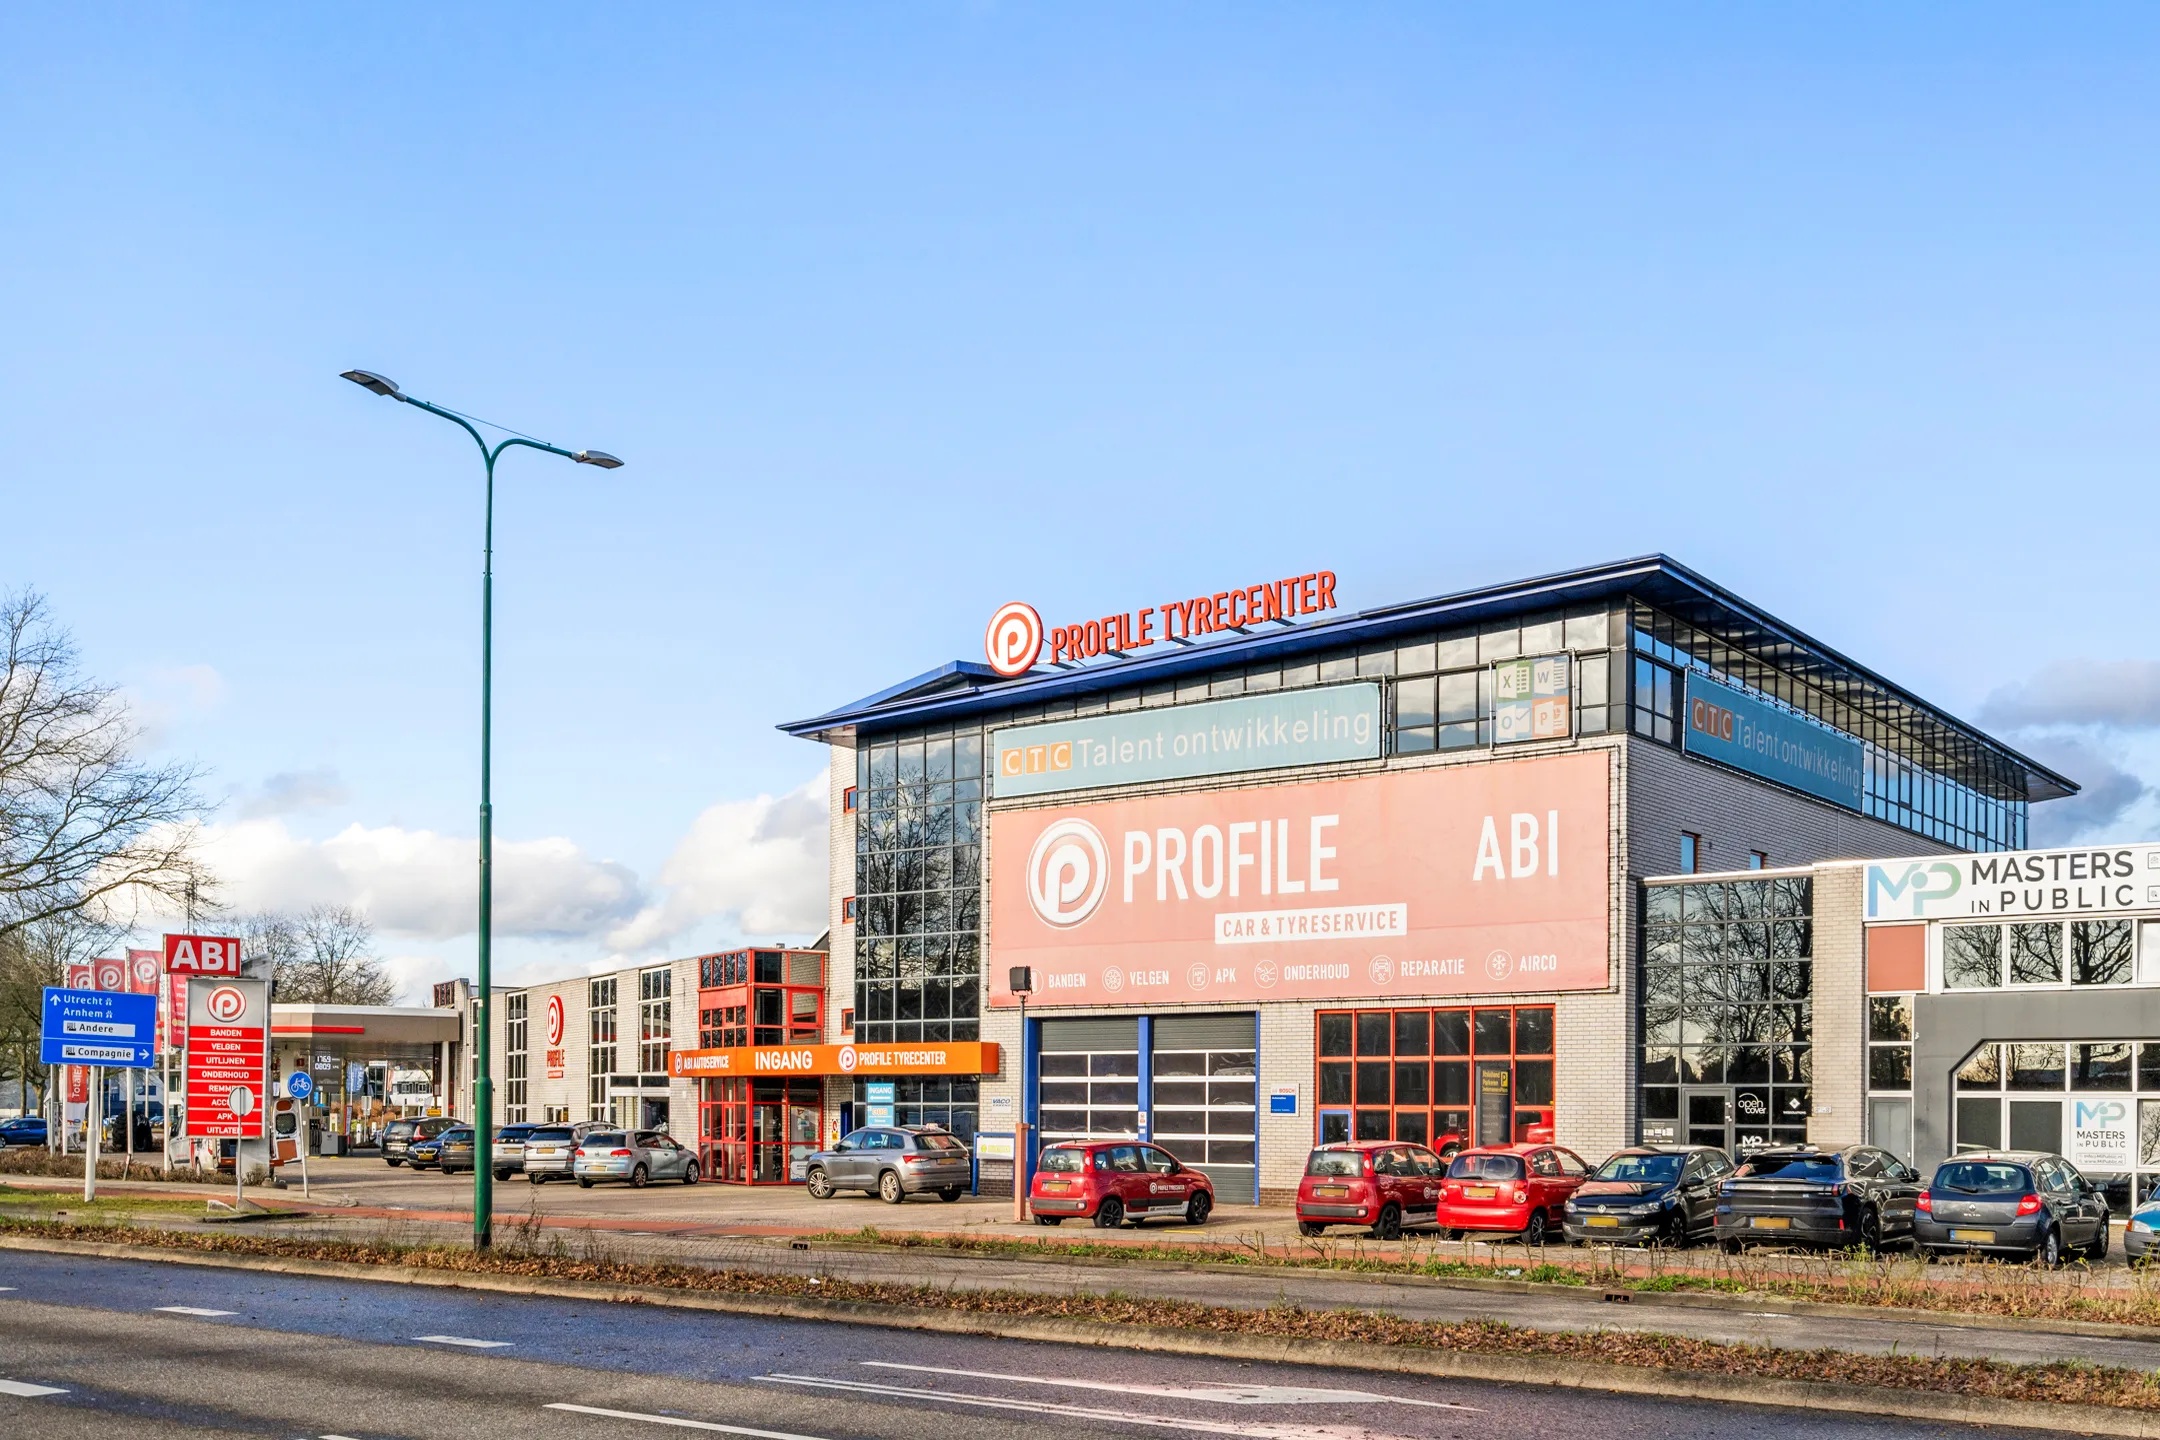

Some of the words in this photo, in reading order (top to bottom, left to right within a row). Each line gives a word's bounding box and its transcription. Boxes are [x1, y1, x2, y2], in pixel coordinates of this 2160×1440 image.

[1052, 608, 1154, 664] PROFILE
[1160, 570, 1337, 641] TYRECENTER
[1503, 674, 1512, 688] X
[1537, 670, 1550, 684] W
[1004, 744, 1069, 774] CTC
[1077, 732, 1164, 768] Talent
[1174, 710, 1370, 756] ontwikkeling
[1694, 702, 1731, 739] CTC
[1736, 714, 1778, 760] Talent
[1782, 741, 1859, 796] ontwikkeling
[1472, 810, 1559, 881] ABI
[1124, 814, 1339, 902] PROFILE
[1971, 850, 2134, 886] MASTERS
[1972, 900, 1990, 914] IN
[2000, 884, 2134, 912] PUBLIC
[1223, 918, 1255, 937] CAR
[1260, 918, 1270, 936] &
[1276, 910, 1397, 935] TYRESERVICE
[170, 940, 236, 971] ABI
[1519, 954, 1557, 972] AIRCO
[1215, 968, 1236, 984] APK
[1284, 963, 1350, 981] ONDERHOUD
[1400, 959, 1465, 977] REPARATIE
[1048, 973, 1086, 988] BANDEN
[1129, 970, 1169, 986] VELGEN
[64, 995, 102, 1005] Utrecht
[63, 1008, 103, 1018] Arnhem
[79, 1024, 114, 1033] Andere
[78, 1048, 131, 1058] Compagnie
[684, 1057, 693, 1069] ABI
[694, 1055, 729, 1069] AUTOSERVICE
[755, 1050, 813, 1070] INGANG
[859, 1052, 892, 1066] PROFILE
[893, 1051, 946, 1065] TYRECENTER
[1738, 1100, 1764, 1109] open
[2077, 1131, 2126, 1139] MASTERS
